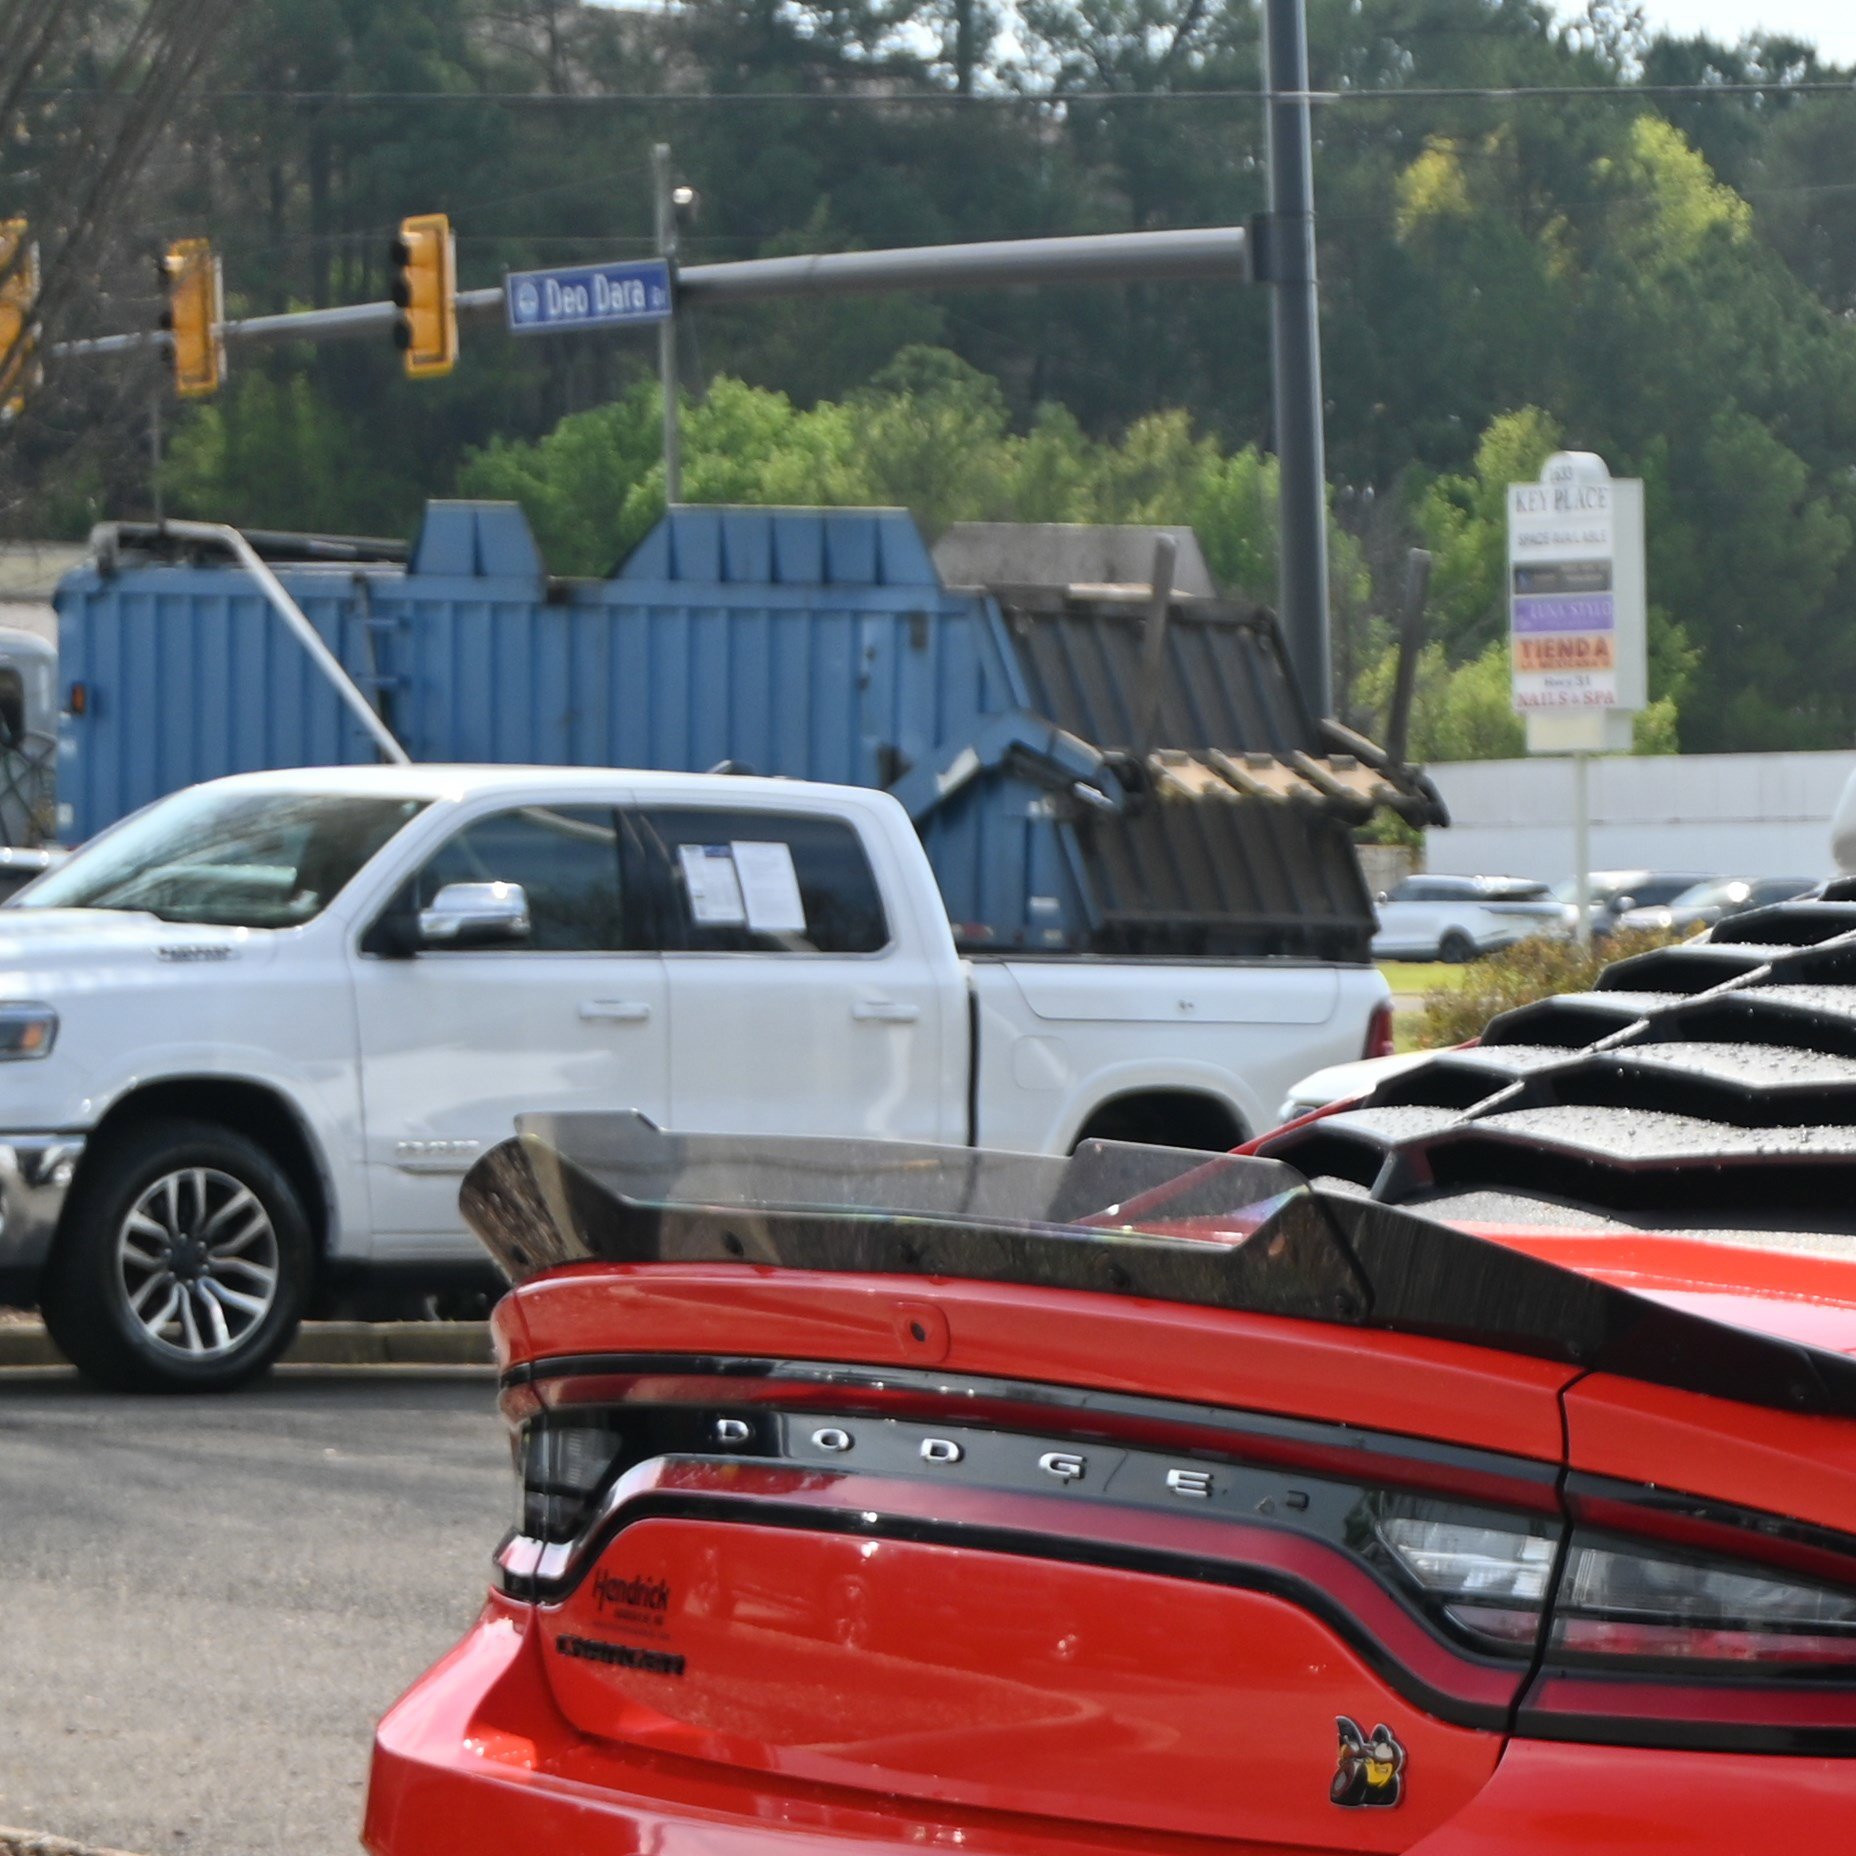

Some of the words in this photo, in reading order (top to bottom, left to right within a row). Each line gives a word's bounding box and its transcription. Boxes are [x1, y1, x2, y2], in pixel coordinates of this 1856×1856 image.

[544, 278, 589, 314] Deo
[593, 273, 647, 312] Dara
[1516, 488, 1547, 512] KEY
[1554, 486, 1608, 511] PLACE
[1520, 637, 1609, 659] TIENDA
[1517, 690, 1568, 706] NAILS
[1583, 689, 1615, 705] SPA
[717, 1418, 1216, 1499] DODGE
